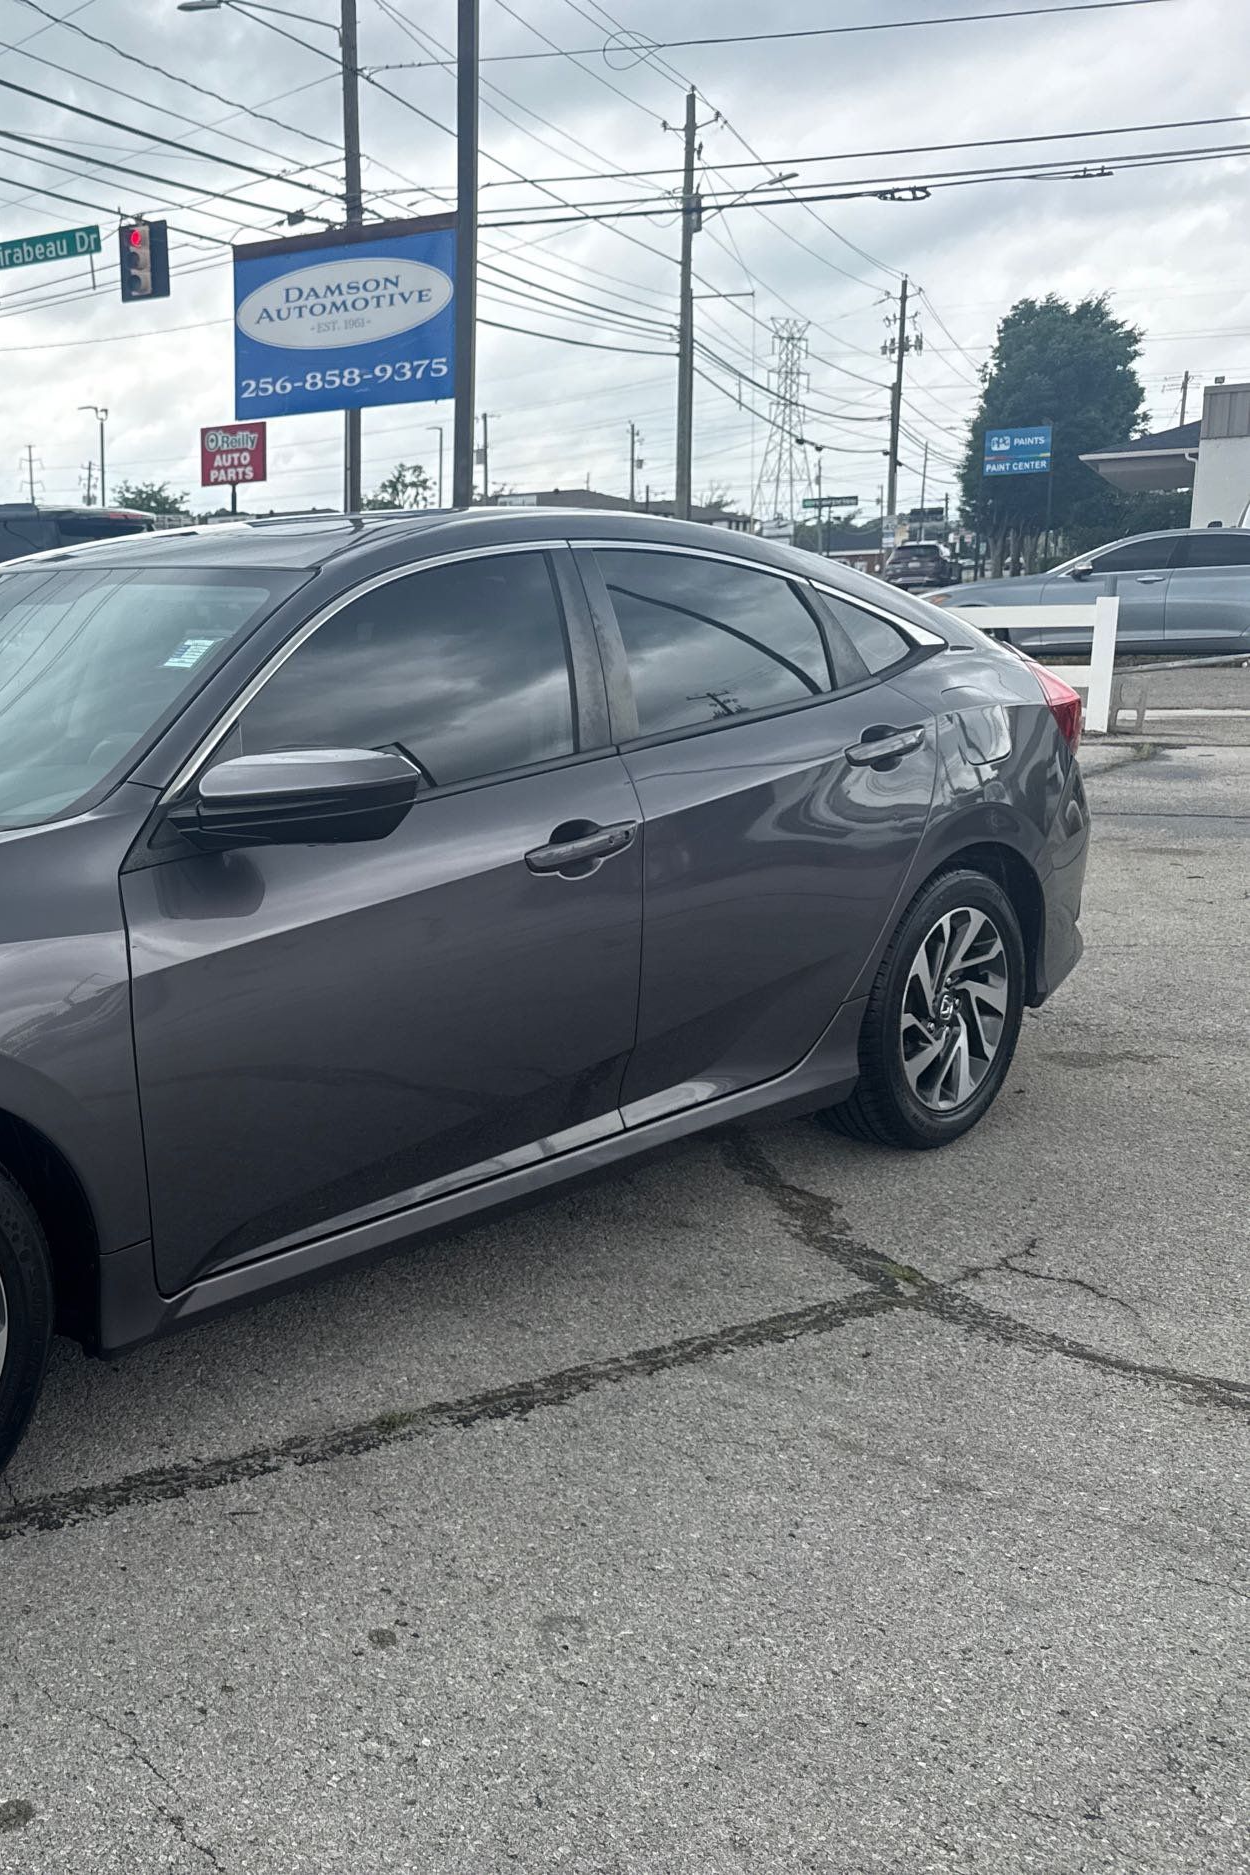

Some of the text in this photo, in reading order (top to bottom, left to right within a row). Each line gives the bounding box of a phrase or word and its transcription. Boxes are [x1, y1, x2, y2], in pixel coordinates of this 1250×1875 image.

[75, 230, 97, 253] Dr
[285, 275, 400, 304] DAMSON
[255, 288, 432, 324] AUTOMOTIVE
[240, 357, 449, 399] 256-858-9375
[205, 430, 258, 452] O'Reilly
[1013, 436, 1045, 446] PAINTS
[213, 452, 250, 468] AUTO
[986, 460, 1047, 473] PAINT CENTER
[210, 466, 254, 482] PARTS
